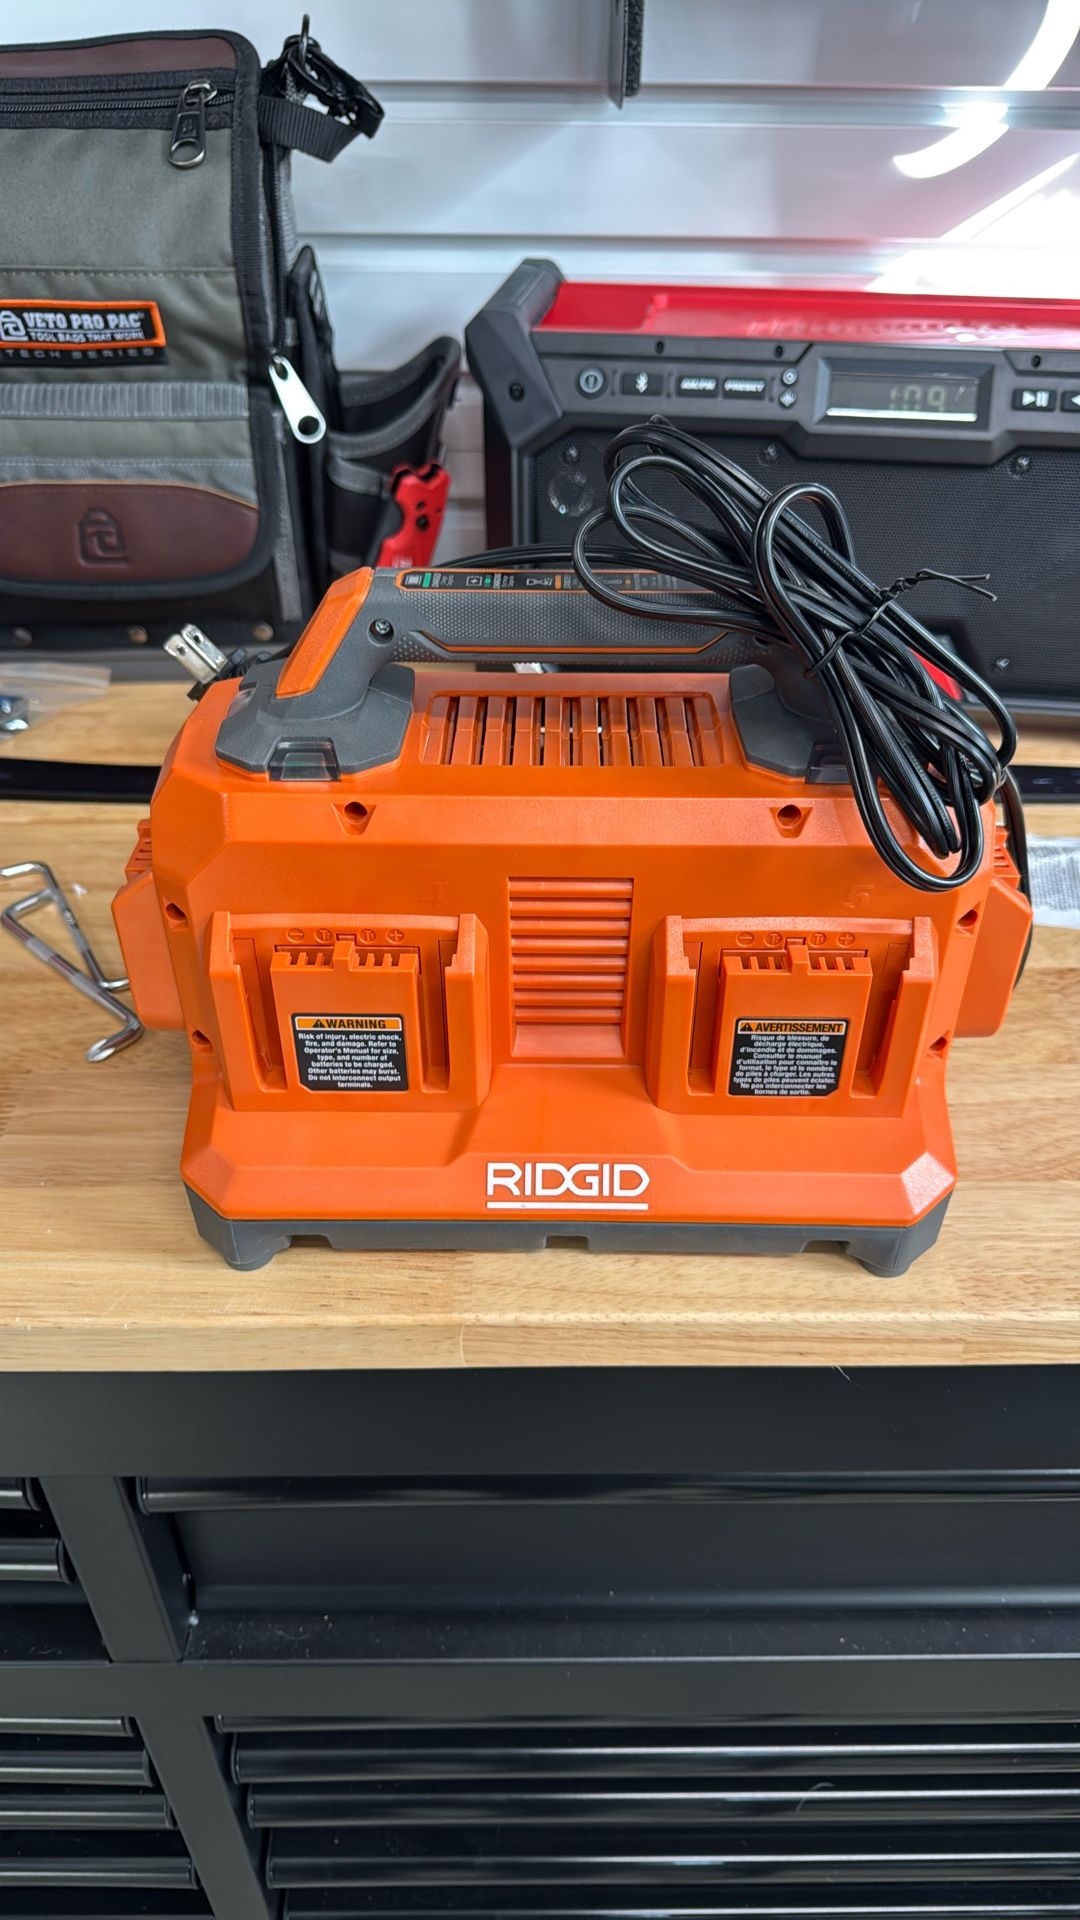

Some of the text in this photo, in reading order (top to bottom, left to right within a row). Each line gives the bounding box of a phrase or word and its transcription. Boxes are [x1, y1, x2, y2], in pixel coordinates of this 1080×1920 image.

[22, 312, 68, 329] VETO
[69, 313, 105, 330] PRO
[29, 331, 145, 343] TOOL BAGS THAT WORK
[5, 347, 154, 360] TECH SERIES
[326, 1019, 386, 1029] WARNING
[755, 1023, 843, 1032] AVERTISSEMENT
[487, 1162, 650, 1197] RIDGID
